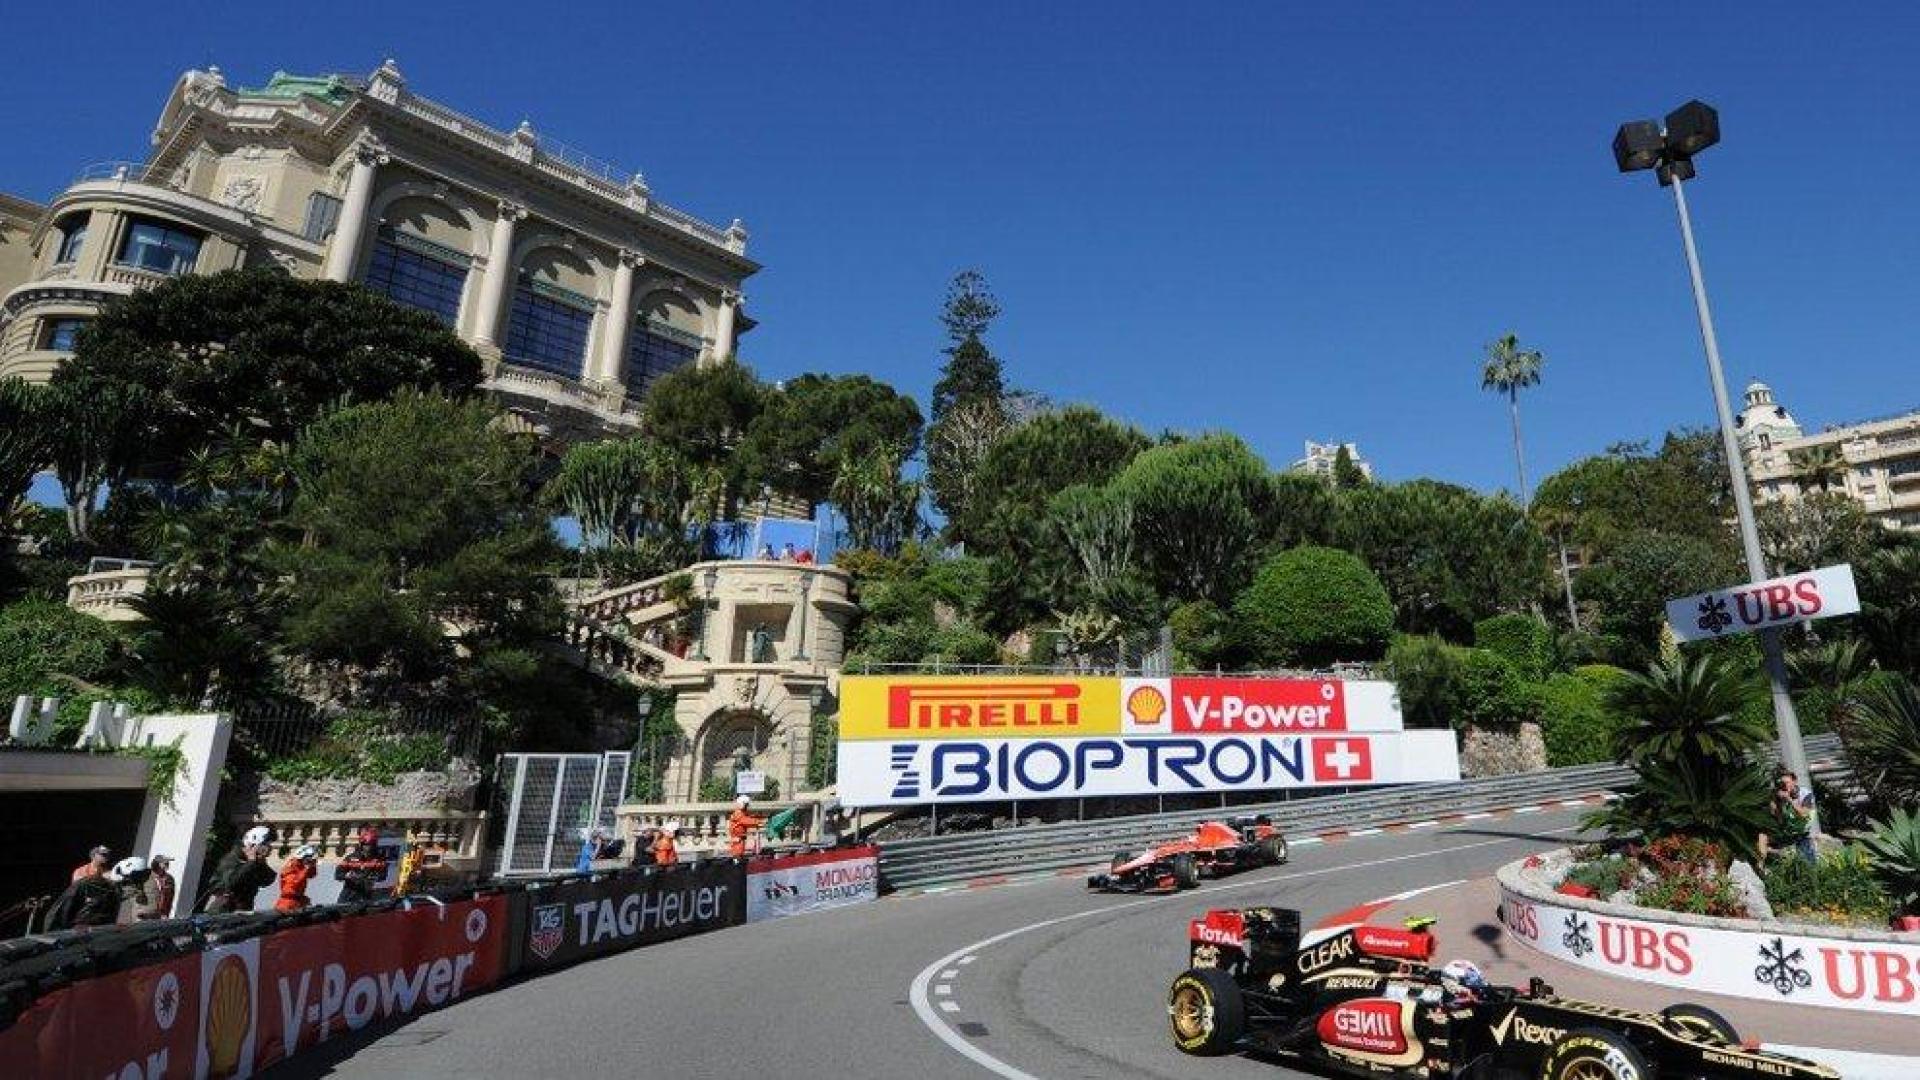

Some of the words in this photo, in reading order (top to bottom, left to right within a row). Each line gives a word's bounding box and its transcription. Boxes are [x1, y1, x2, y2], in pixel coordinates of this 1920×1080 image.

[1733, 578, 1822, 625] UBS
[887, 683, 1081, 729] PIRELLI
[1182, 694, 1331, 729] V-Power
[930, 737, 1304, 796] BIOPTRON
[1196, 923, 1244, 946] TOTAL
[1509, 900, 1539, 941] UBS
[1298, 933, 1354, 973] CLEAR
[1597, 919, 1694, 976] UBS
[1817, 947, 1920, 1003] UB
[278, 950, 476, 1057] V-Power
[1702, 1051, 1754, 1070] RICHARD
[1756, 1061, 1793, 1077] MILLE
